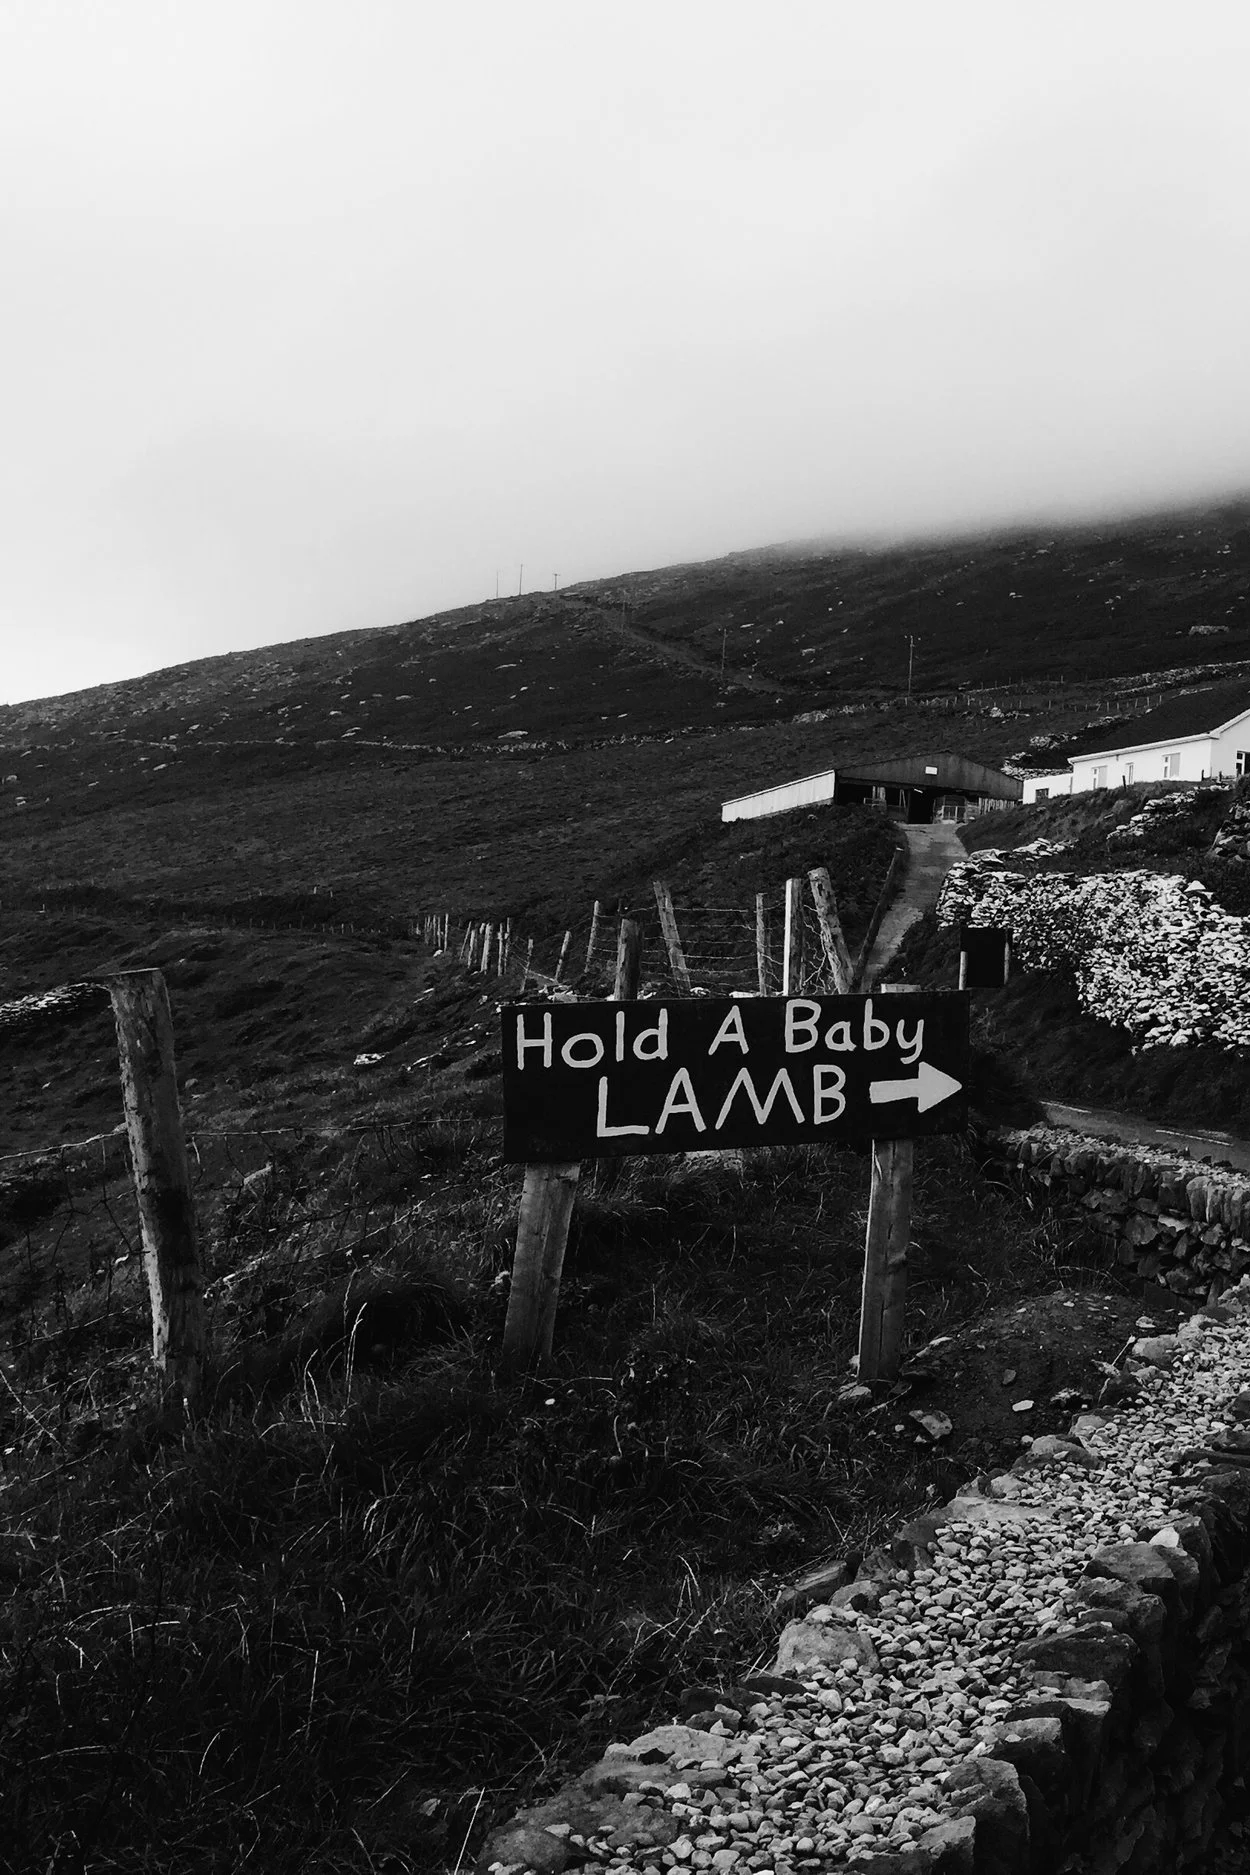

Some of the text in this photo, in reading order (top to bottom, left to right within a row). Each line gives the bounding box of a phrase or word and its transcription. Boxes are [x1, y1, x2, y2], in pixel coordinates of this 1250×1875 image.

[516, 998, 925, 1071] Hold A Baby
[596, 1064, 847, 1138] LAMB
